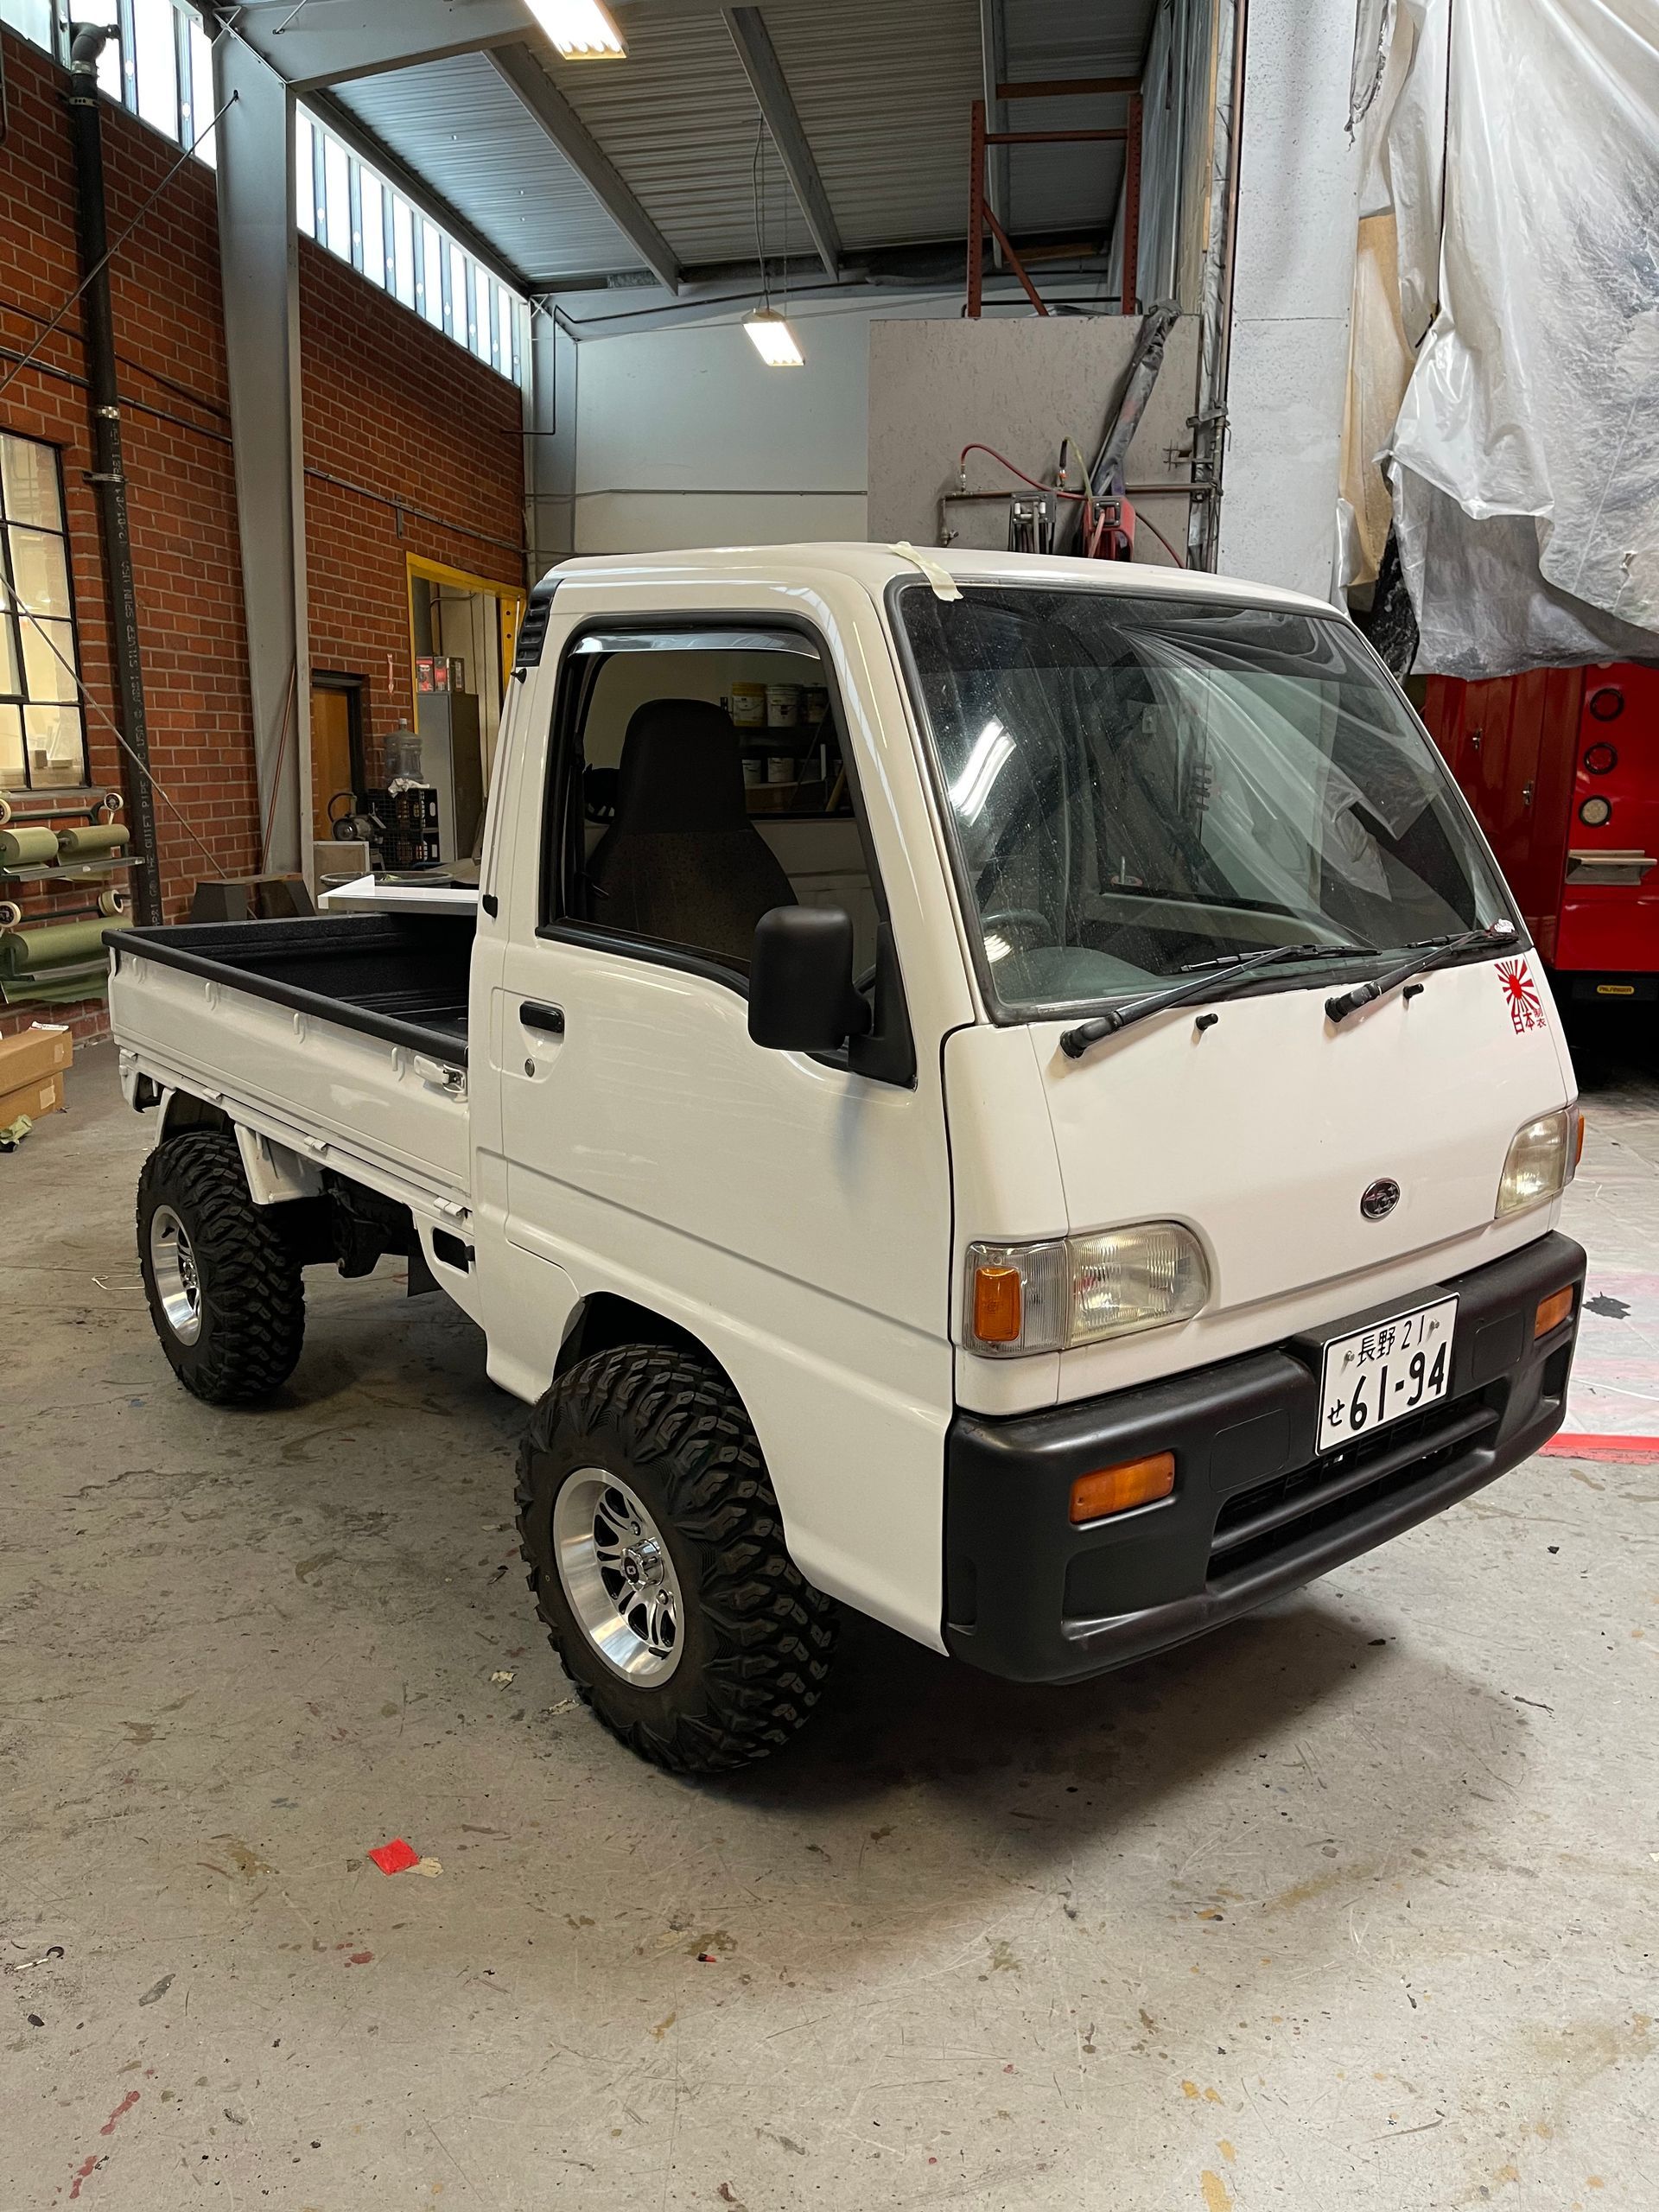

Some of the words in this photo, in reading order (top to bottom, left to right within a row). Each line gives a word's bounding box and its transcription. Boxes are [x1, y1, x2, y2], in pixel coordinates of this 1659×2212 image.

[124, 589, 134, 618] SPUN
[127, 625, 138, 668] SILVER
[135, 725, 145, 747] USA
[140, 780, 149, 808] PIPE
[143, 814, 153, 849] QUIET
[1350, 1341, 1447, 1431] 61-94
